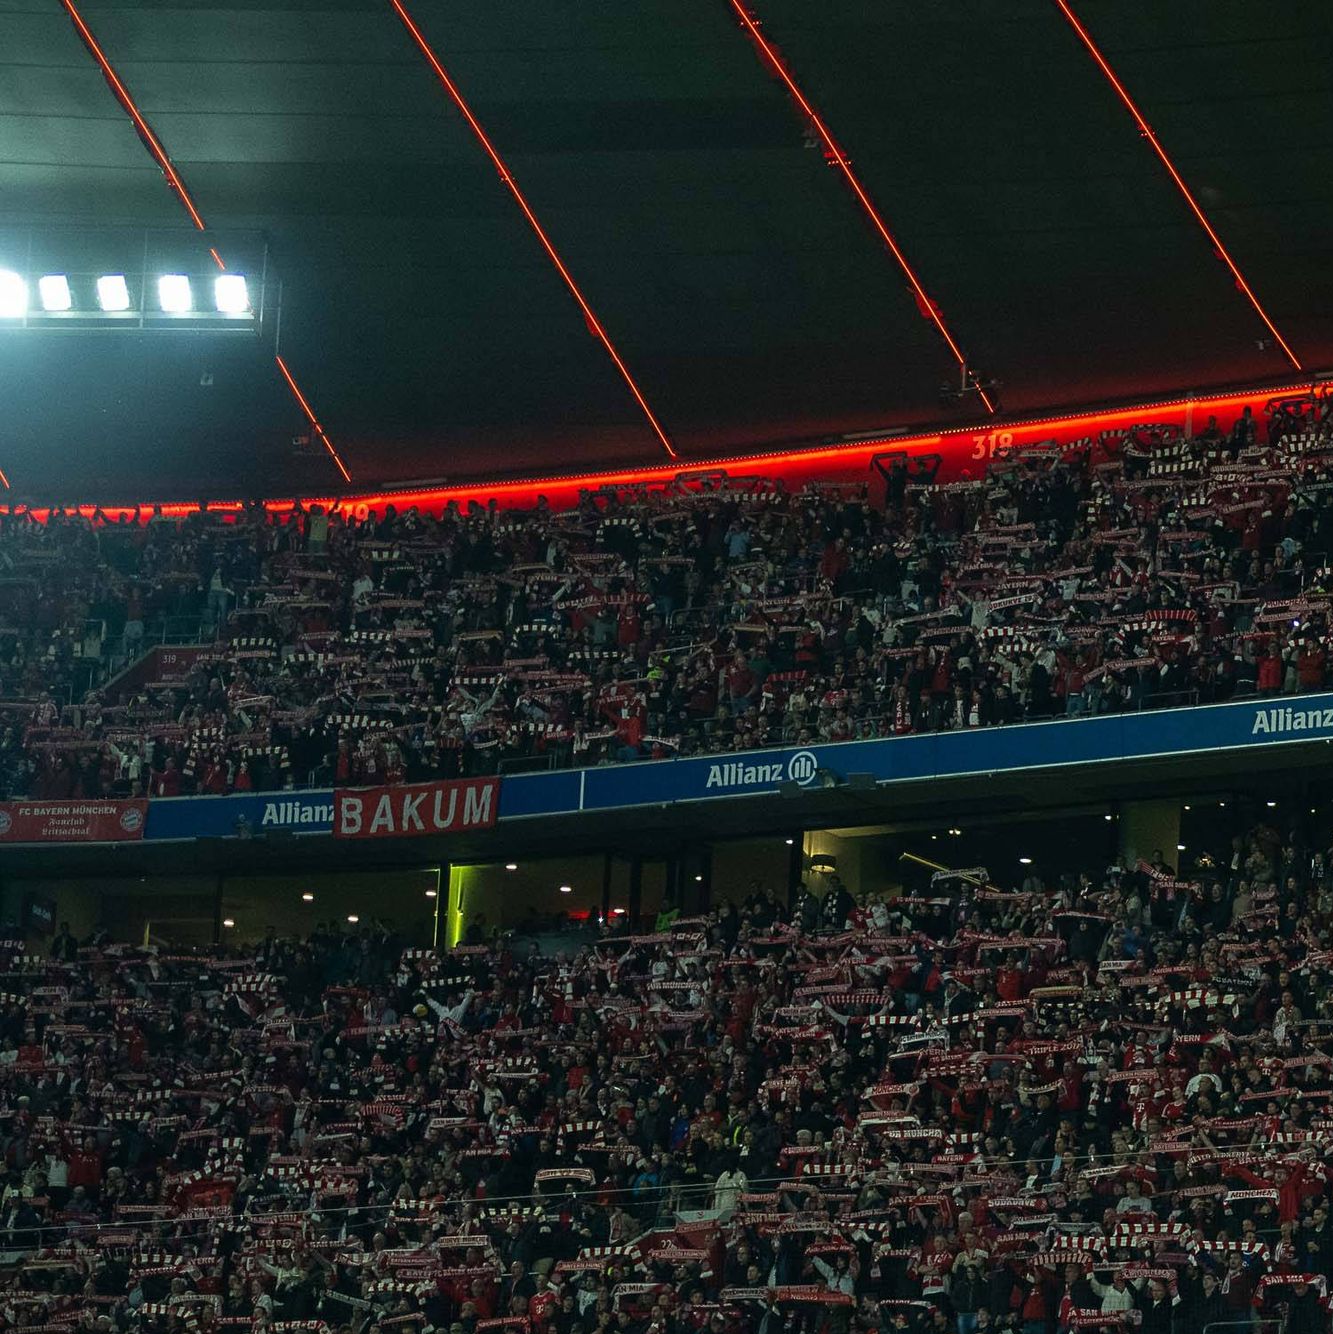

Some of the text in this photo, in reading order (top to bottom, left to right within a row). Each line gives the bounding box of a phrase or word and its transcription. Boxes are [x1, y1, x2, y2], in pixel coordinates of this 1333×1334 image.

[706, 760, 783, 788] Allianz
[34, 806, 69, 816] BAYERN
[72, 805, 117, 816] MÜNCHEN
[340, 783, 492, 836] BAKUM
